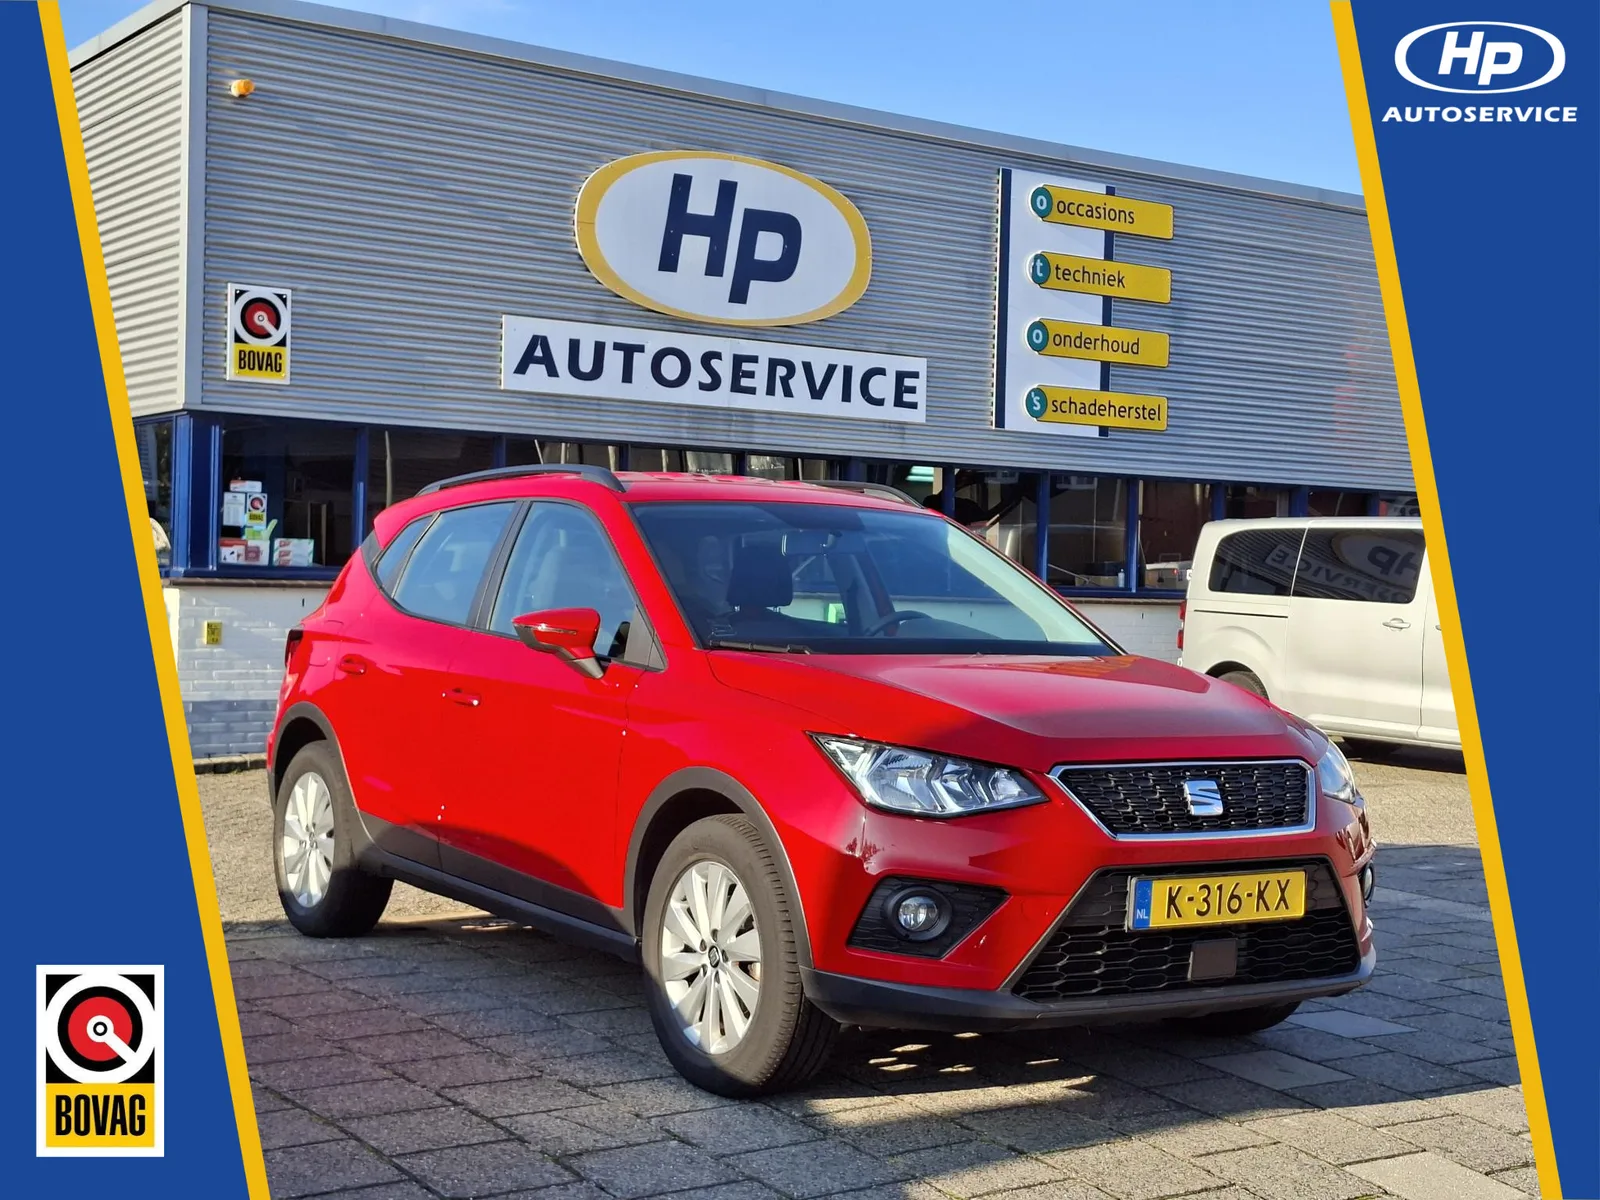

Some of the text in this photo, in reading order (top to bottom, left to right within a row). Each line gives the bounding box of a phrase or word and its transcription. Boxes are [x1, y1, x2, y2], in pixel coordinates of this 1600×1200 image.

[1056, 199, 1135, 225] occasions
[1055, 264, 1126, 289] techniek
[1053, 331, 1140, 355] onderhoud
[238, 349, 283, 373] BOVAG
[513, 334, 920, 410] AUTOSERVICE
[1051, 396, 1162, 422] schadeherstel
[1165, 879, 1291, 919] K-316-KX
[1136, 908, 1149, 920] NL
